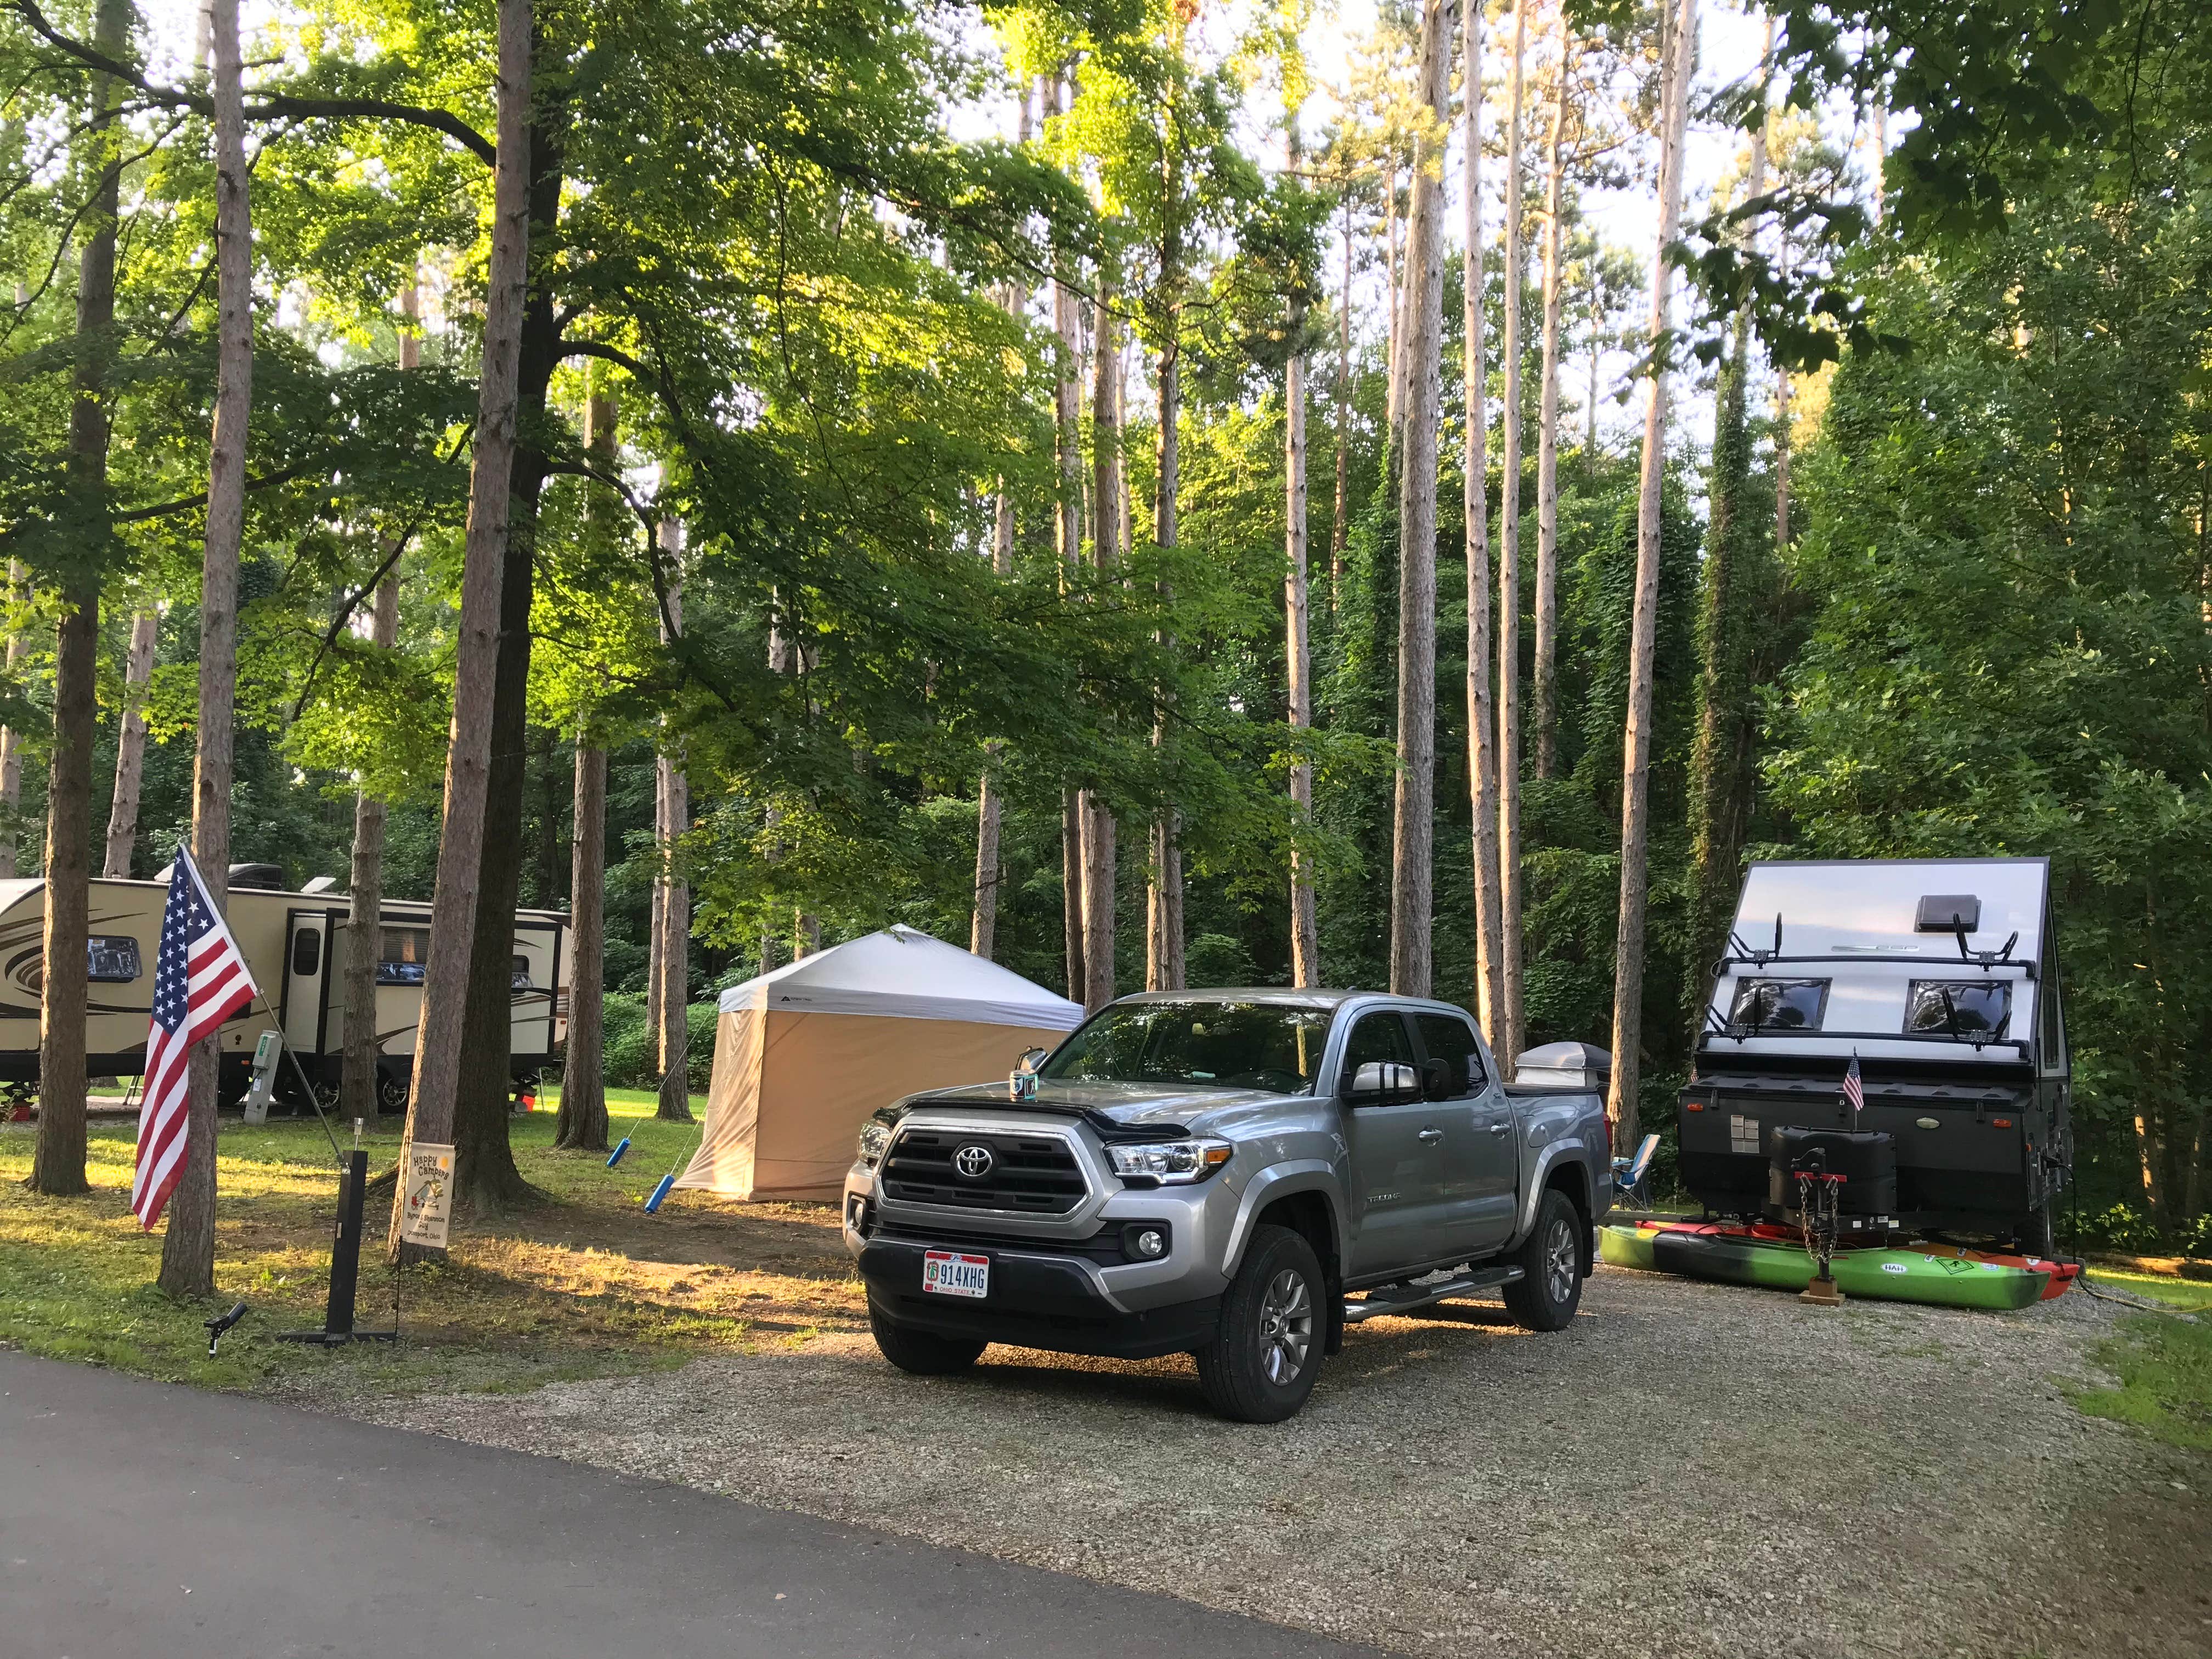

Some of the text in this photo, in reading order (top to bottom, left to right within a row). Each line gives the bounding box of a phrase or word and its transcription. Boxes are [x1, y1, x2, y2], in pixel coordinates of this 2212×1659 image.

[414, 1155, 437, 1166] Happy
[418, 1166, 449, 1180] Campers
[941, 1265, 984, 1289] 914XHG
